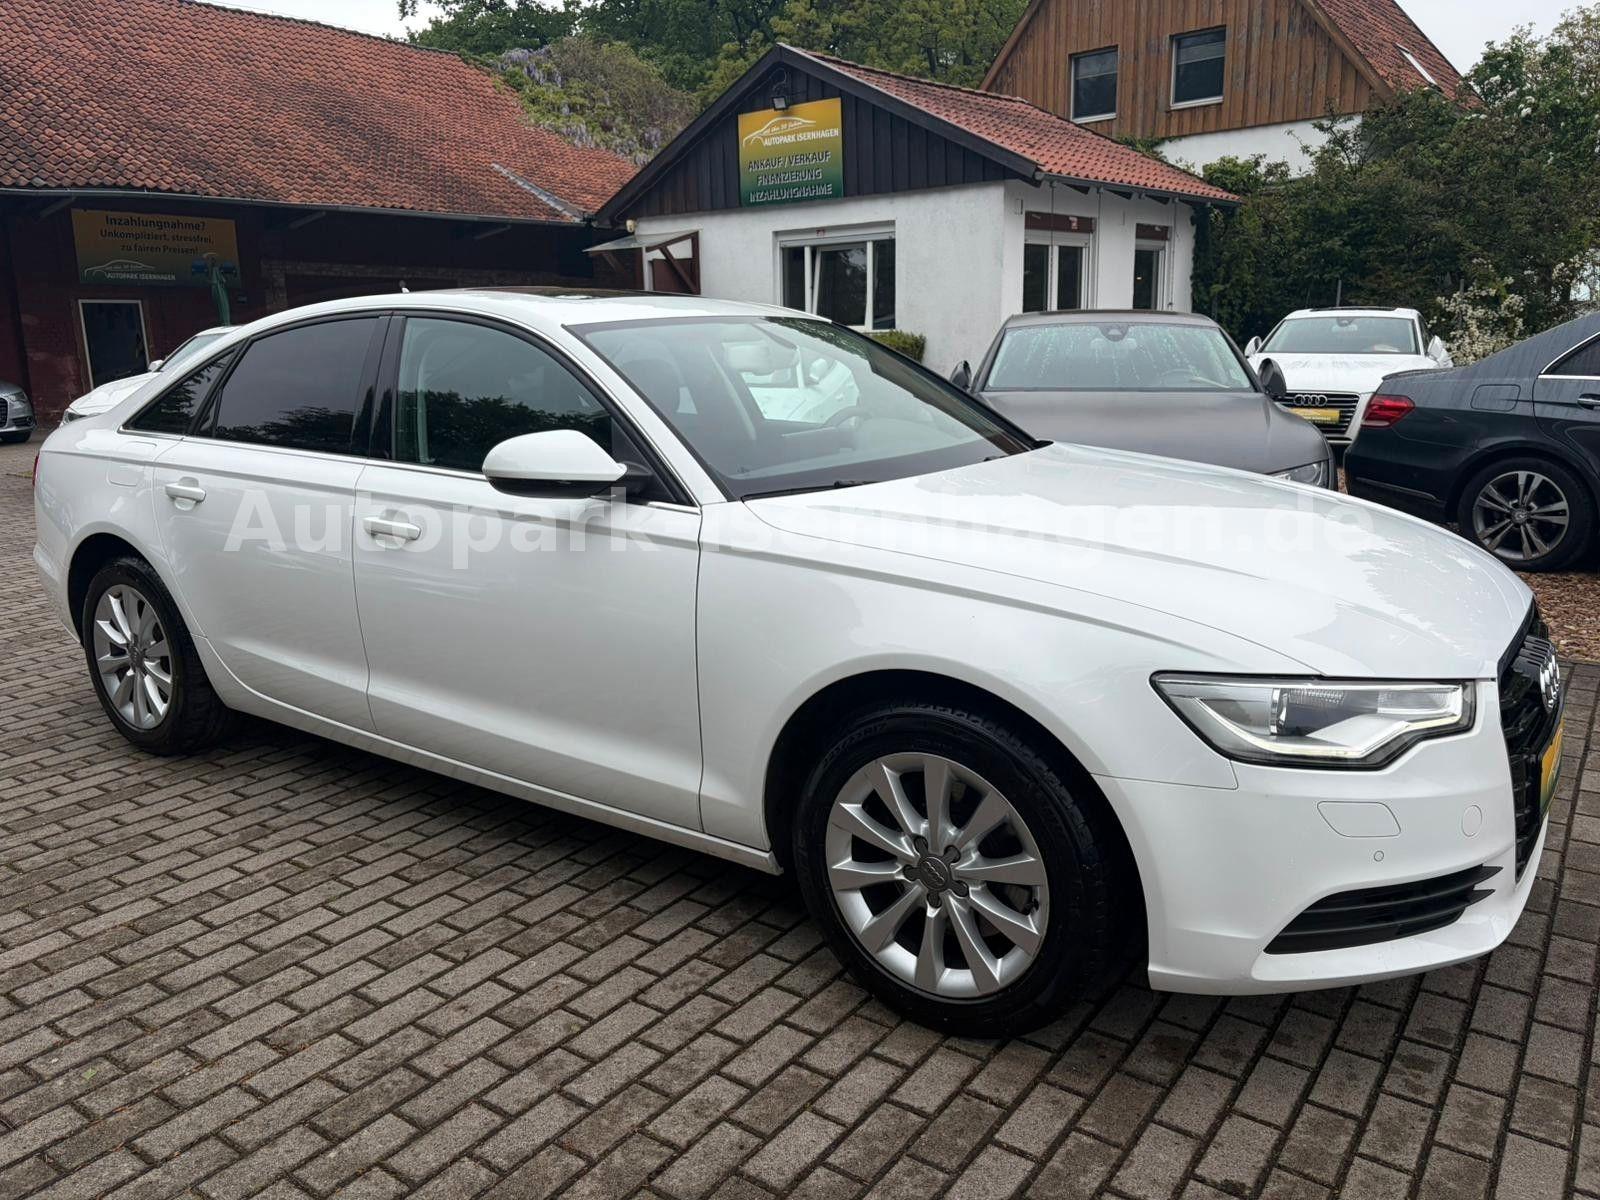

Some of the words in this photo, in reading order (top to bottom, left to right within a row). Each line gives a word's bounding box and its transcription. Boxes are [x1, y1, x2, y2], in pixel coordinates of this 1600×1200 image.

[764, 134, 796, 146] AUTOPARK
[797, 128, 839, 143] ISERNHAGEN
[748, 157, 782, 172] ANKAUF
[789, 151, 831, 167] VERKAUF
[757, 168, 823, 187] FINANZIERUNG
[105, 215, 206, 231] Inzahlungnahme?
[100, 229, 169, 241] Unkompliziert,
[171, 233, 214, 245] stressfrei,
[133, 244, 161, 253] fairen
[162, 245, 198, 255] Preisen!
[105, 272, 138, 280] AUTOPARK
